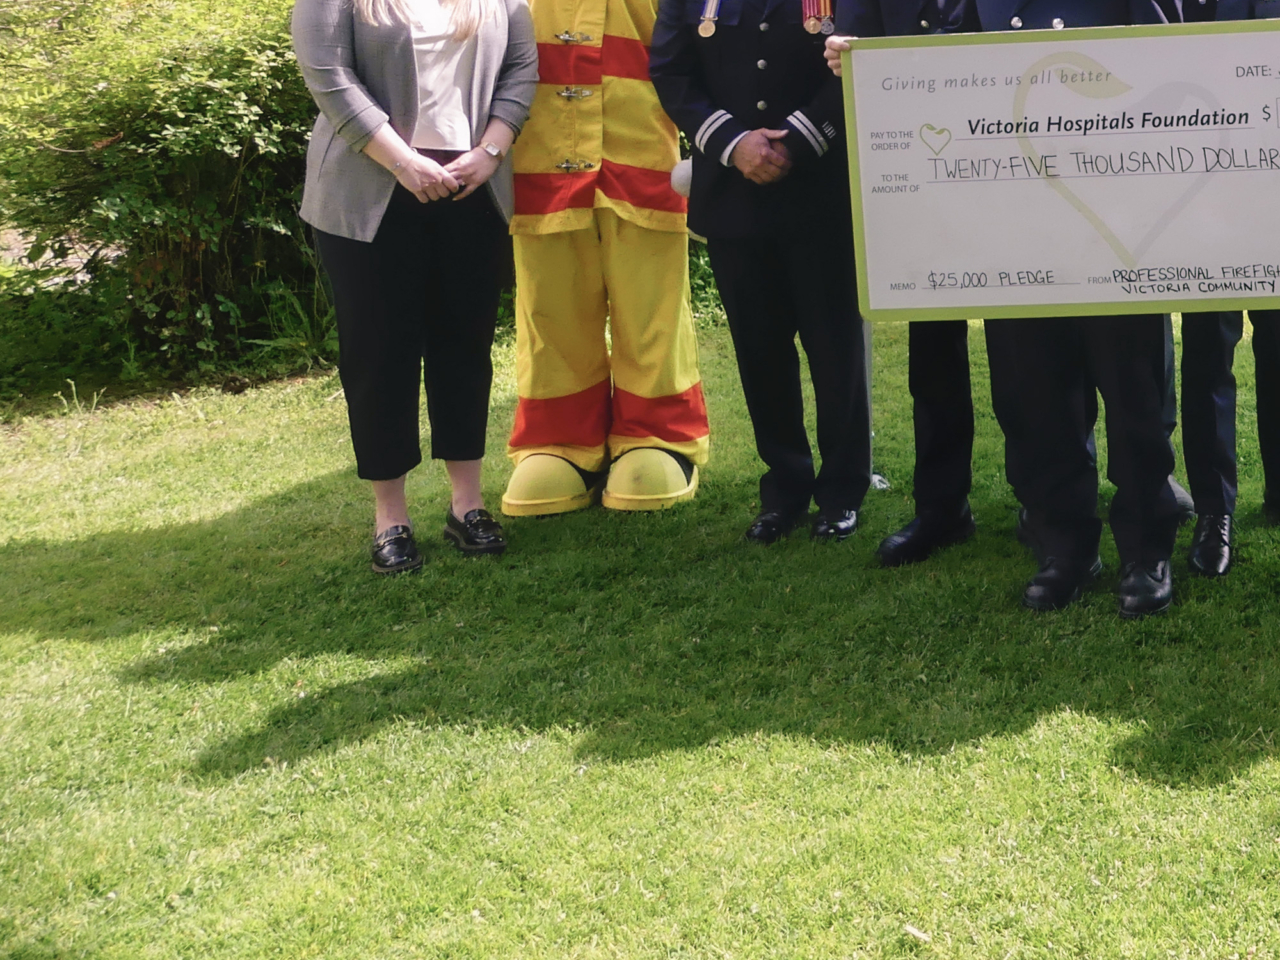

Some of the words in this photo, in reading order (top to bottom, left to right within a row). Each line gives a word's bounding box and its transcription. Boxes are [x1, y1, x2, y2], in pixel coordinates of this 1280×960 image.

[1235, 65, 1272, 78] DATE:
[881, 75, 936, 93] Giving
[944, 73, 997, 89] makes
[1005, 74, 1022, 86] us
[1030, 69, 1051, 85] all
[1060, 70, 1111, 84] better
[1262, 104, 1271, 122] $
[967, 117, 1040, 136] Victoria
[1047, 112, 1135, 136] Hospitals
[1141, 108, 1250, 129] Foundation
[870, 131, 885, 140] PAY
[886, 131, 898, 139] TO
[899, 131, 914, 139] THE
[871, 142, 899, 151] ORDER
[900, 142, 912, 150] OF
[928, 155, 1061, 180] TWENTY-FIVE
[1070, 146, 1194, 174] THOUSAND
[881, 174, 893, 182] TO
[894, 174, 909, 182] THE
[872, 185, 906, 194] AMOUNT
[908, 184, 920, 193] OF
[928, 270, 988, 290] $25,000
[998, 270, 1055, 287] PLEDGE
[1087, 276, 1112, 285] FROM
[1112, 266, 1214, 283] PROFESSIONAL
[890, 282, 916, 290] MEMO
[1121, 281, 1190, 295] VICTORIA
[1198, 280, 1276, 293] COMMUNITY
